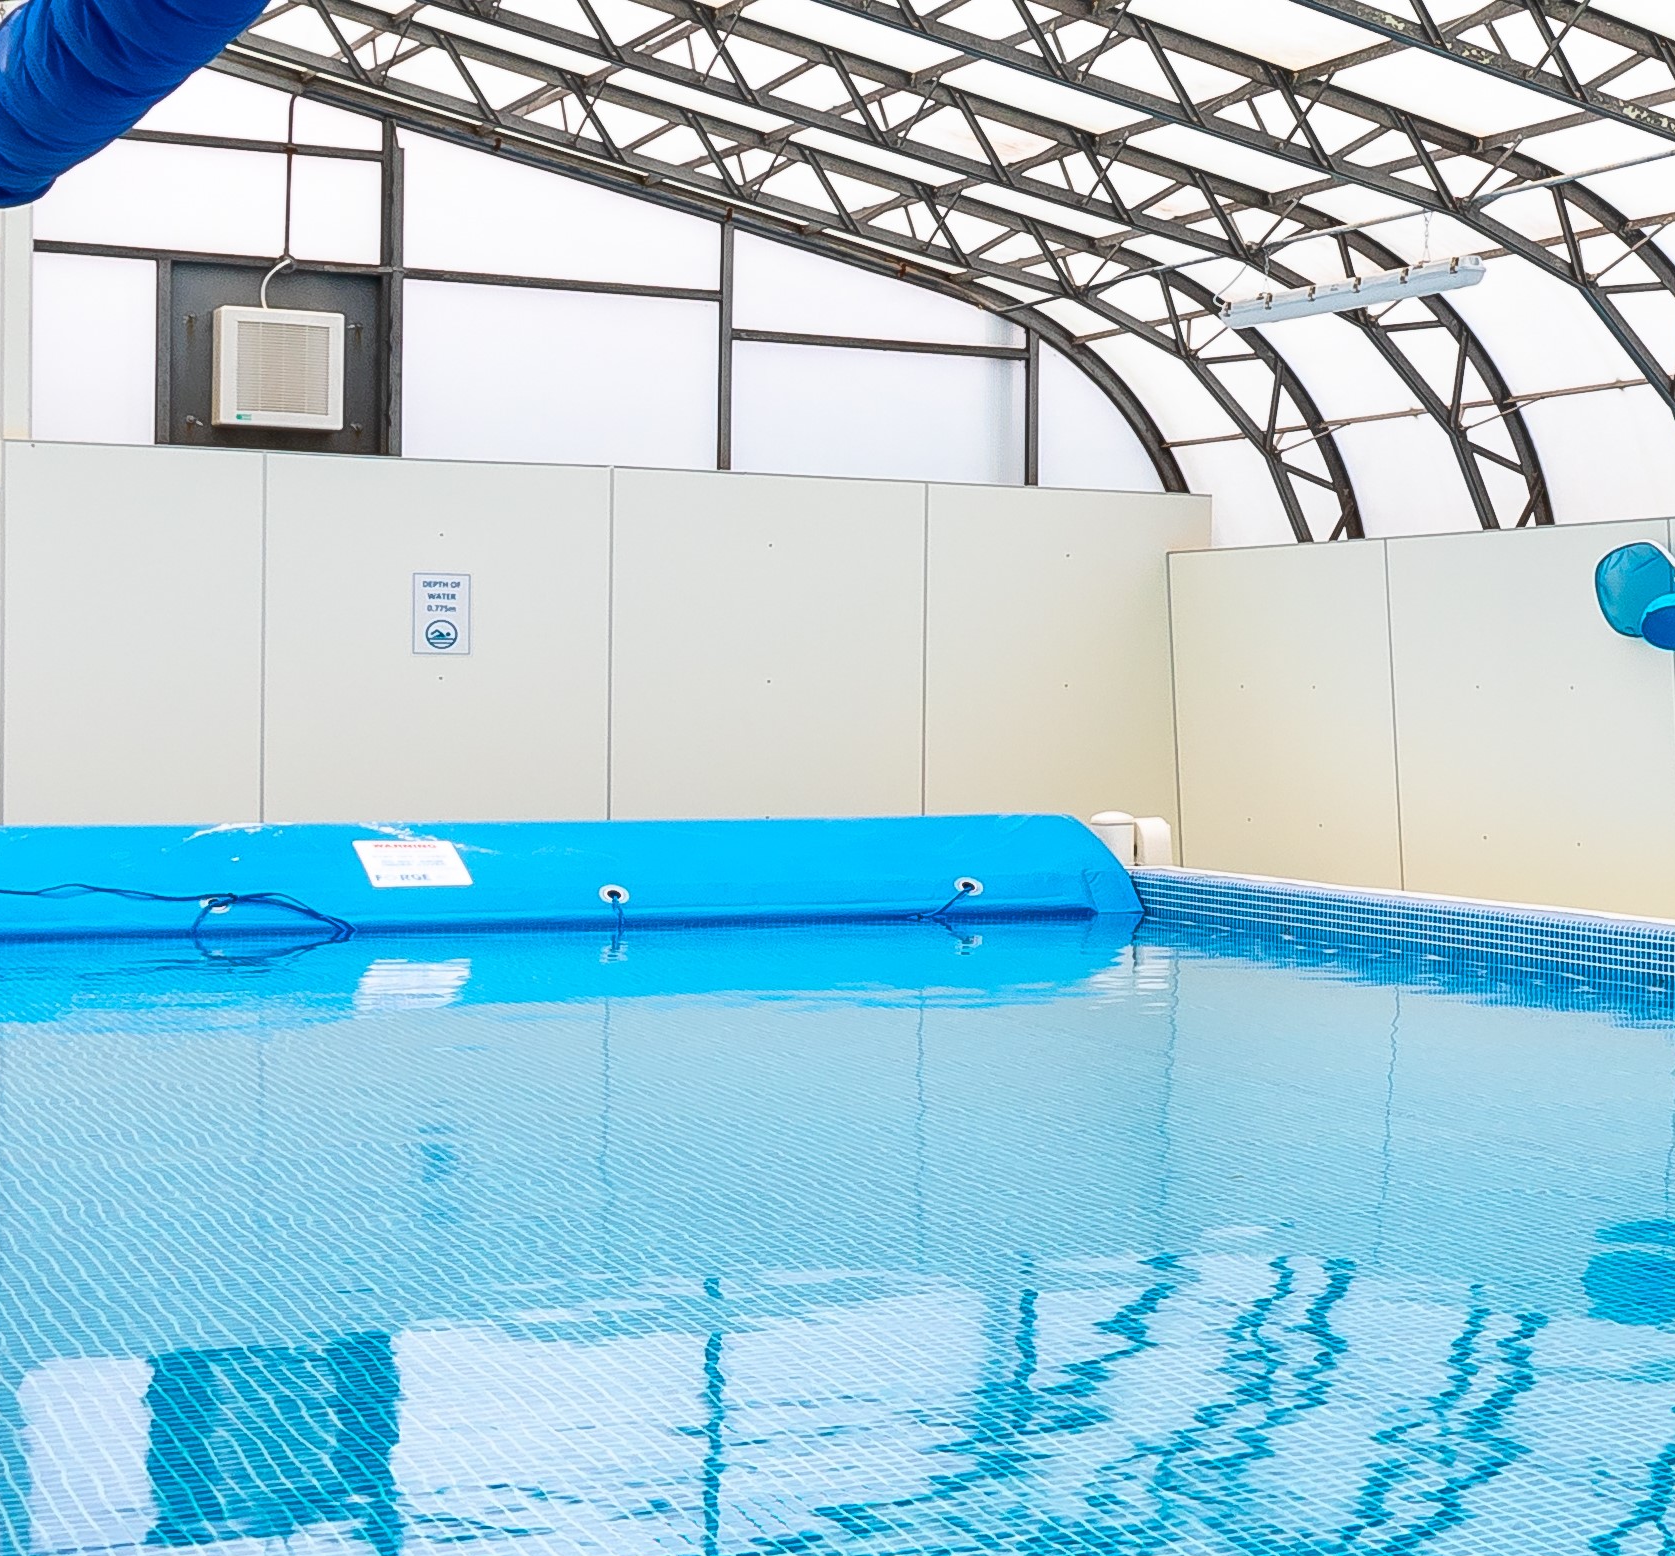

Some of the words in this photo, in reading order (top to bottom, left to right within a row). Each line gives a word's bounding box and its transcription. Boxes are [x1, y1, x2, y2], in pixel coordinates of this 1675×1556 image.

[422, 580, 449, 588] DEPTH
[427, 592, 457, 600] WATER
[426, 604, 457, 612] 0.775m
